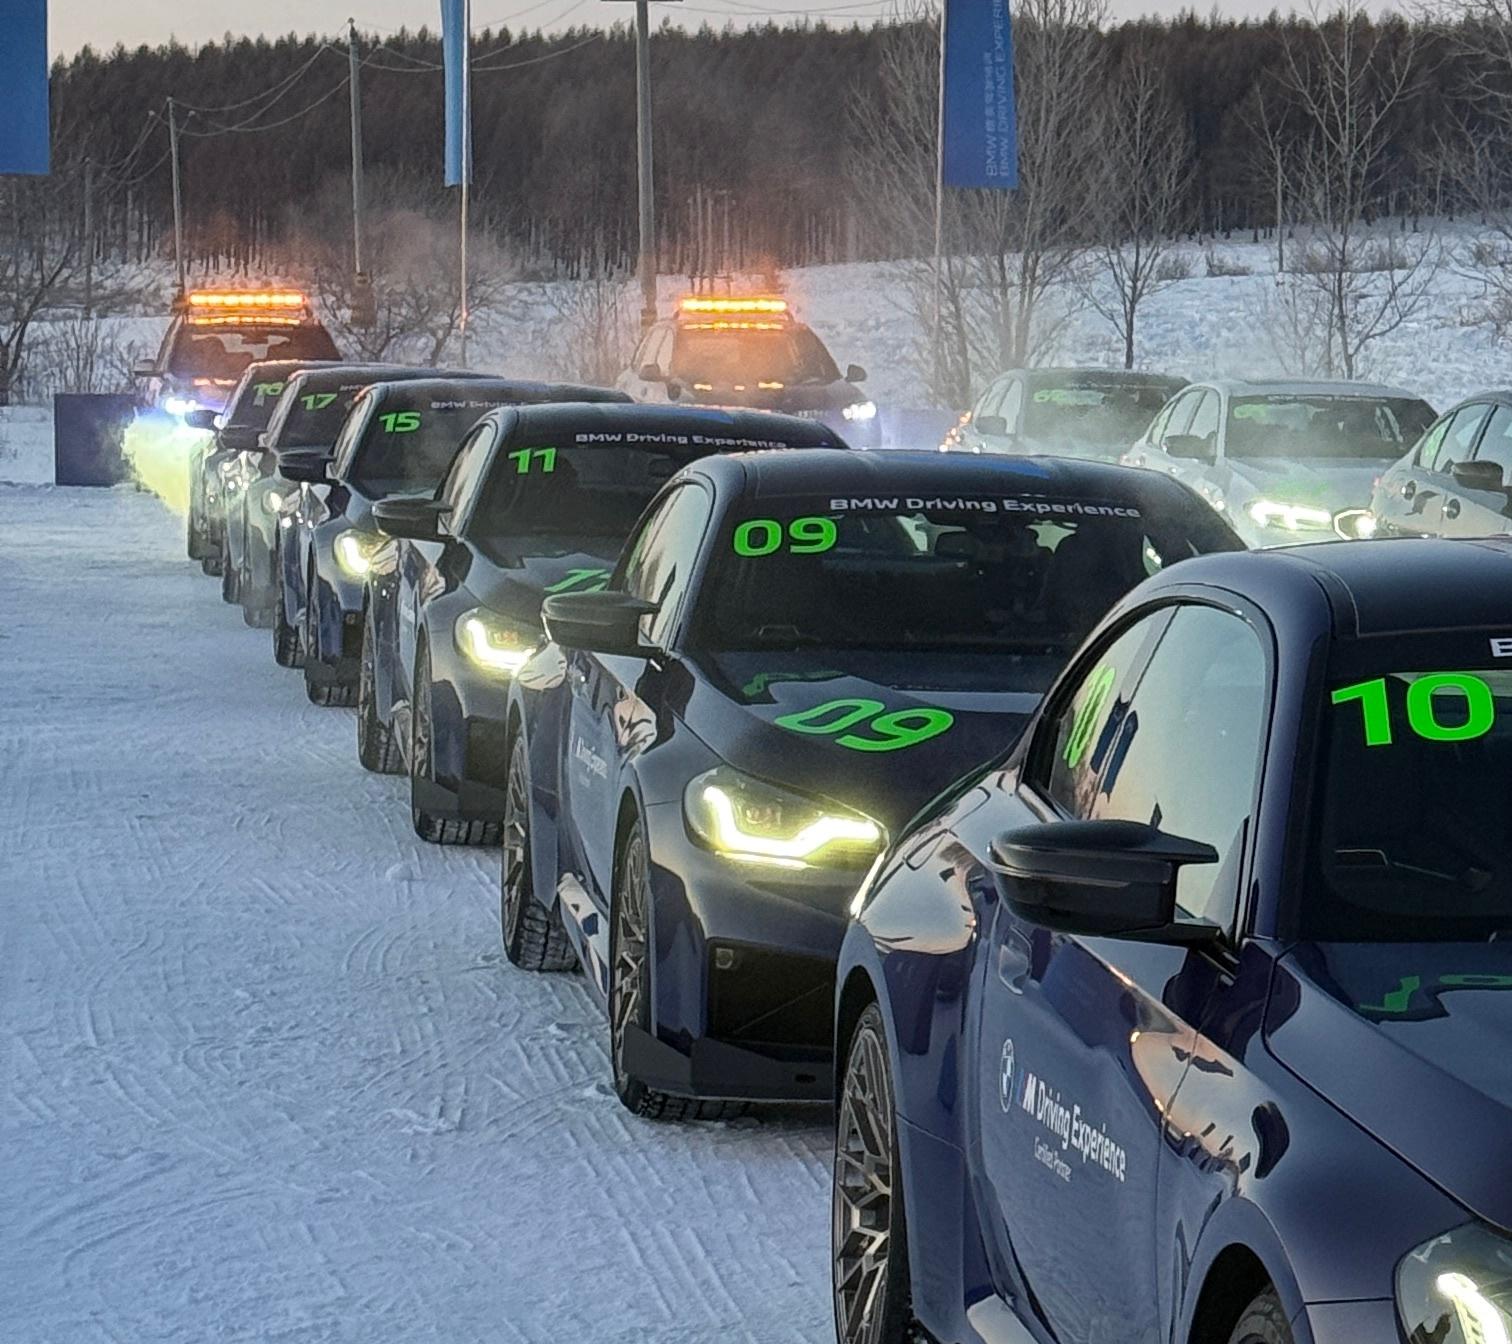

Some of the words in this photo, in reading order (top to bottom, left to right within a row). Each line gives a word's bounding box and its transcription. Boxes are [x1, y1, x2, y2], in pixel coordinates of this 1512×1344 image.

[985, 134, 997, 177] BMW
[301, 393, 338, 411] 17
[379, 411, 422, 433] 15
[575, 433, 622, 443] BMW
[626, 433, 688, 445] Driving
[509, 447, 558, 474] 11
[829, 498, 899, 511] BMW
[905, 497, 997, 514] Driving
[1002, 499, 1142, 518] Experience
[733, 517, 838, 557] 09
[773, 698, 955, 752] 09
[1331, 673, 1495, 746] 10
[1037, 1080, 1071, 1150] Driving
[1071, 1104, 1126, 1183] Experience
